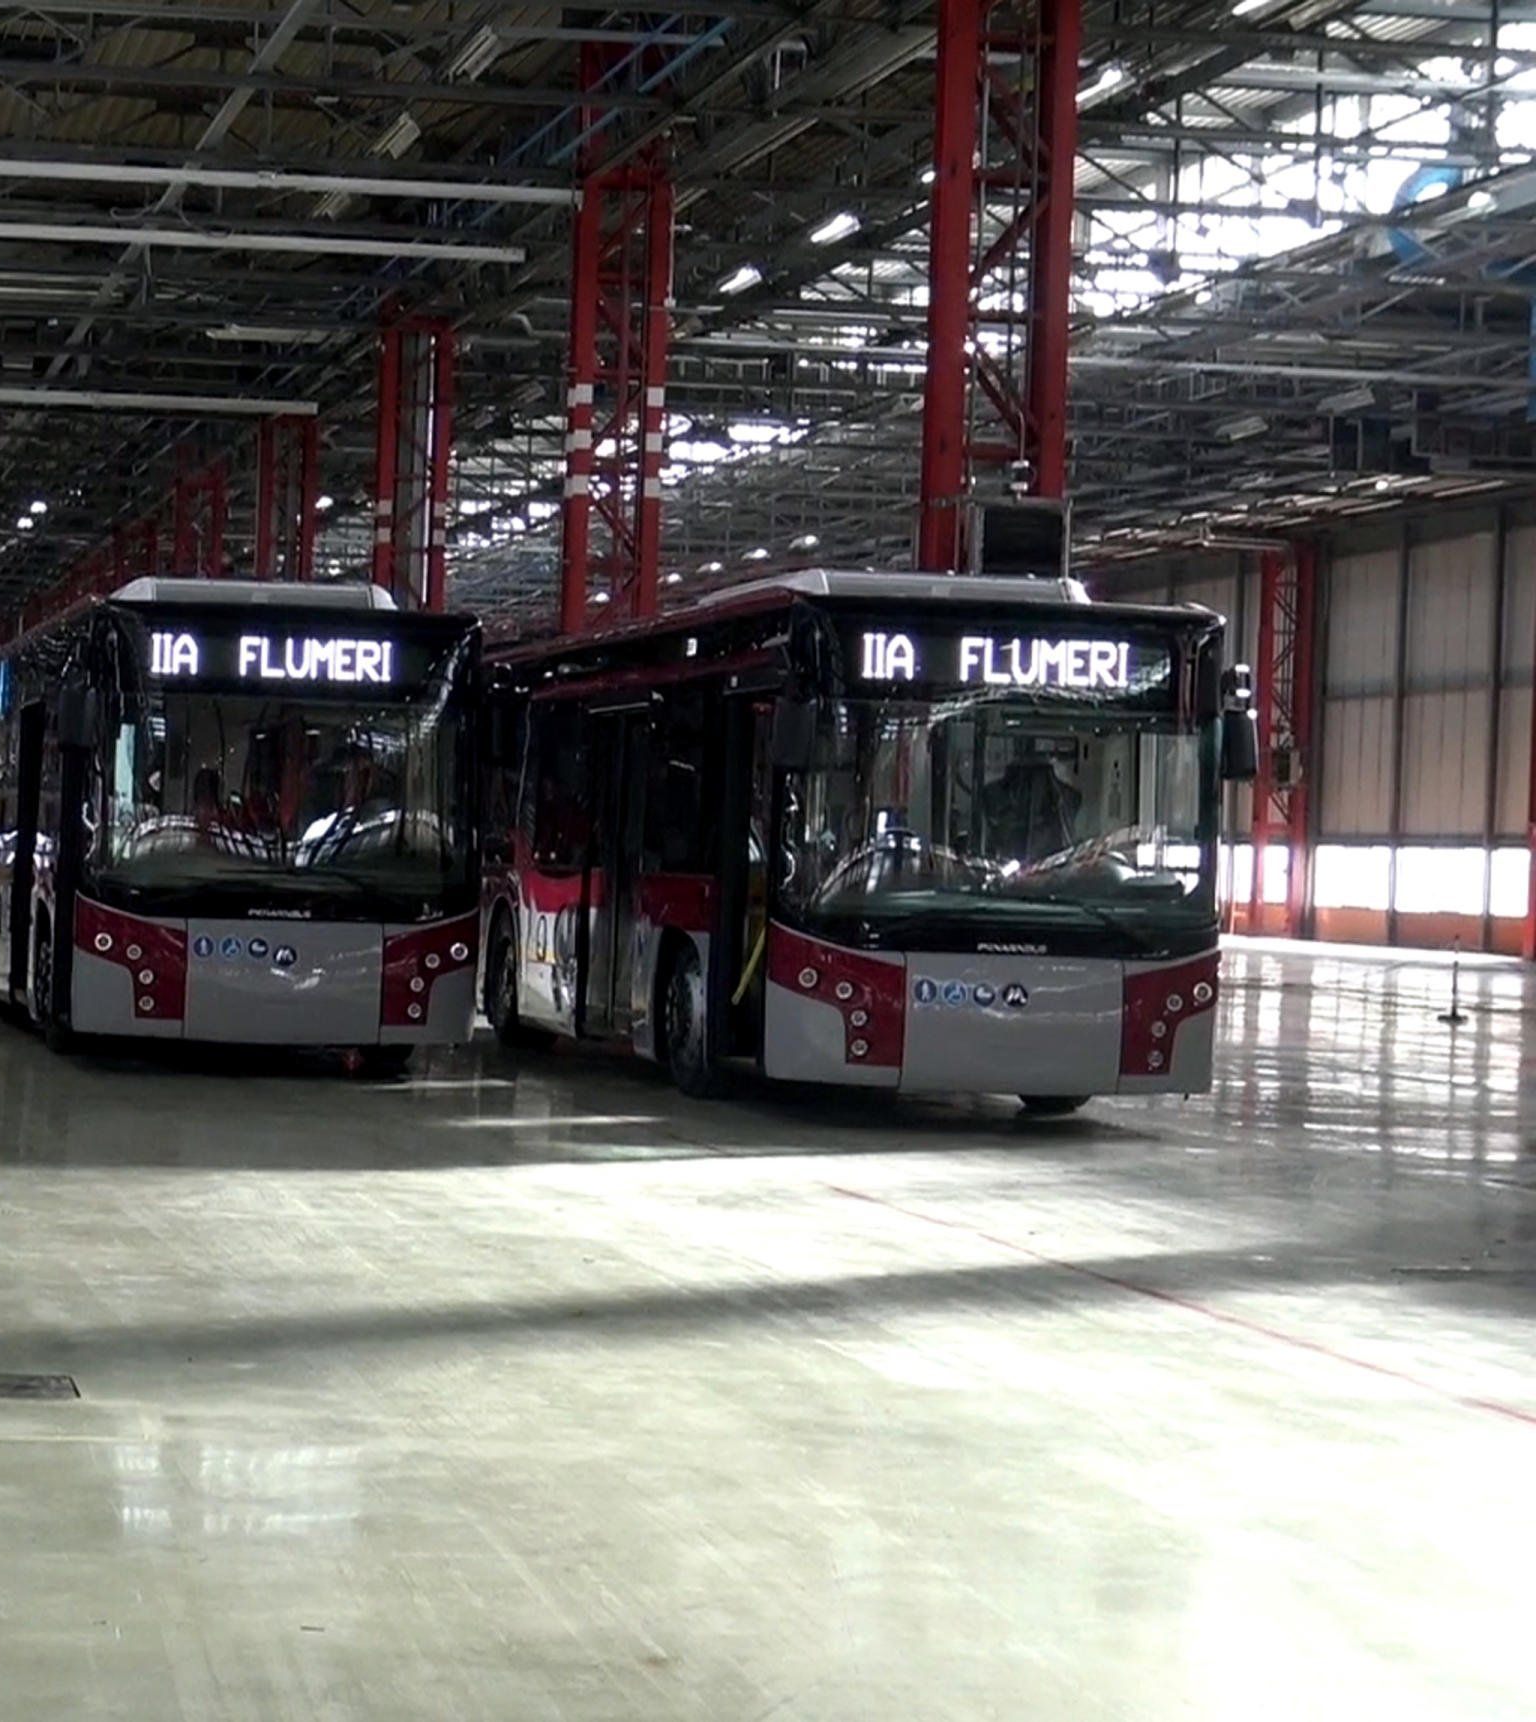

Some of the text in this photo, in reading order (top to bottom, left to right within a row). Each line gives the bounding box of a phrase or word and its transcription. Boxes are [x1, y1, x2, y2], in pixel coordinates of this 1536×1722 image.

[150, 632, 392, 682] IIA FLUMERI
[861, 632, 1131, 687] IIA FLUMERI
